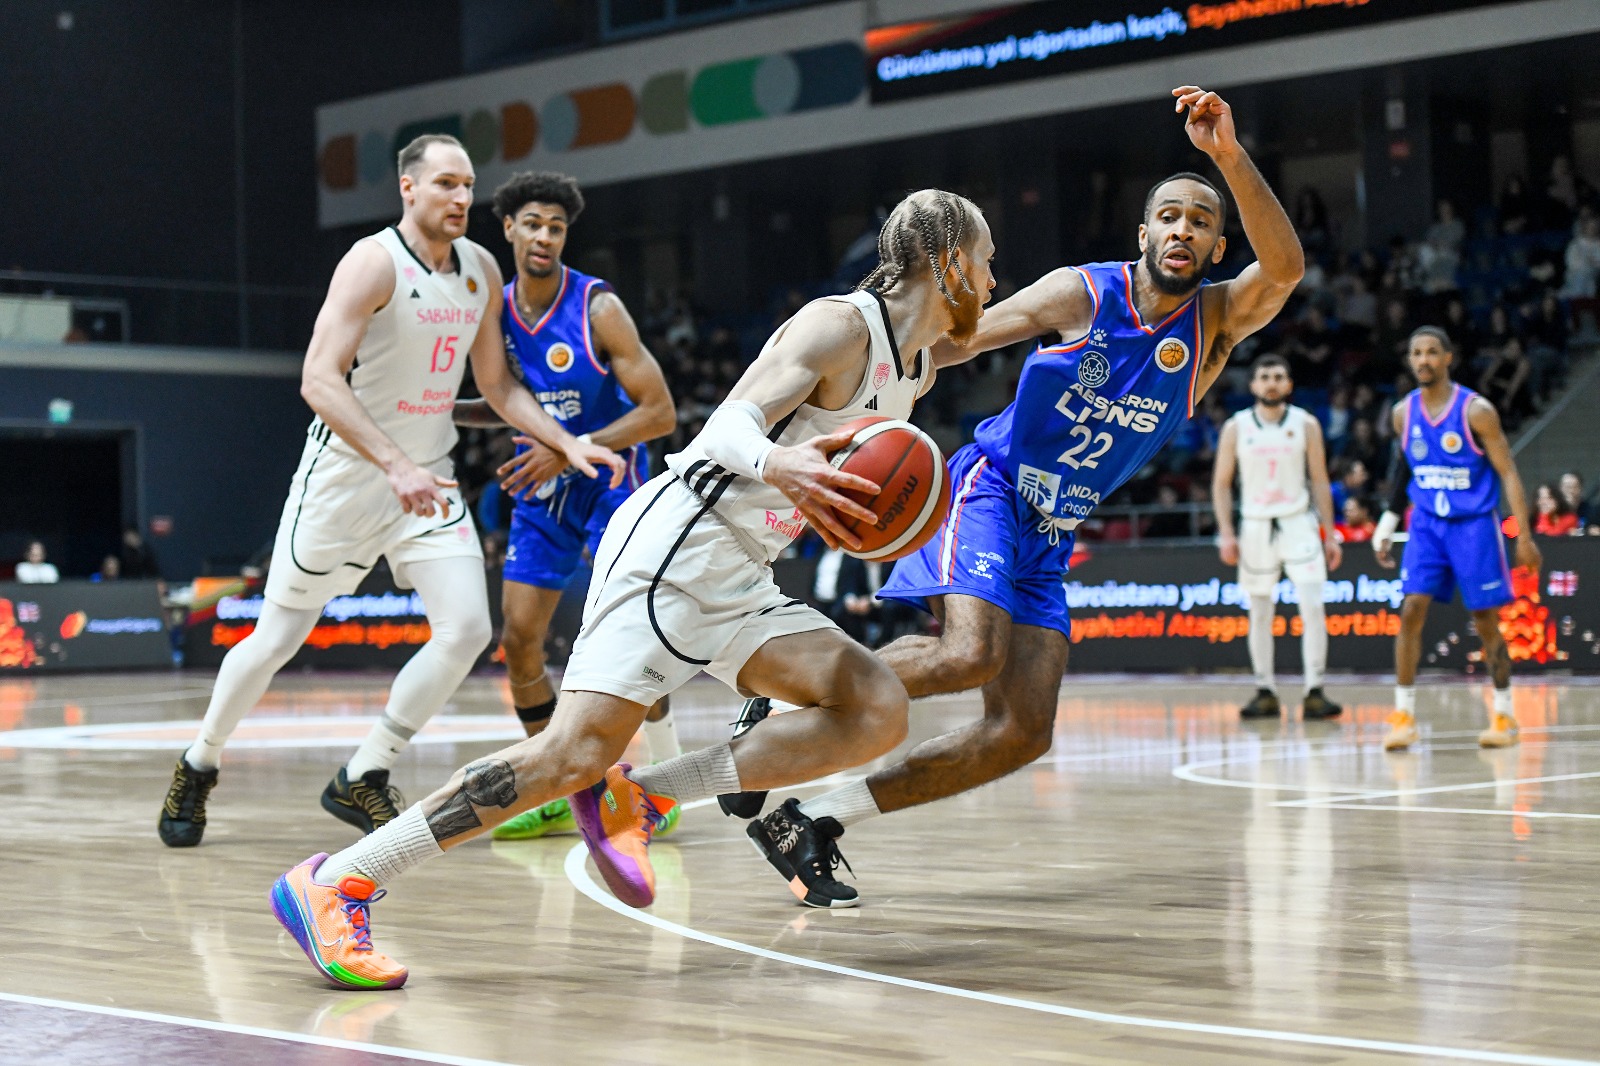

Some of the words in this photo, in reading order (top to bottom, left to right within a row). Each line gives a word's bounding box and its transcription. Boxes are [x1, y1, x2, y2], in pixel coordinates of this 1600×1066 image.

[985, 35, 1017, 69] yol
[416, 308, 461, 324] SABAH
[464, 308, 478, 324] BC
[430, 335, 458, 373] 15
[1057, 424, 1113, 470] 22
[873, 474, 918, 533] molten
[1060, 484, 1100, 505] LINDA
[1063, 580, 1179, 608] ürcüstana
[1179, 577, 1220, 611] yol
[642, 665, 666, 683] BRIDGE
